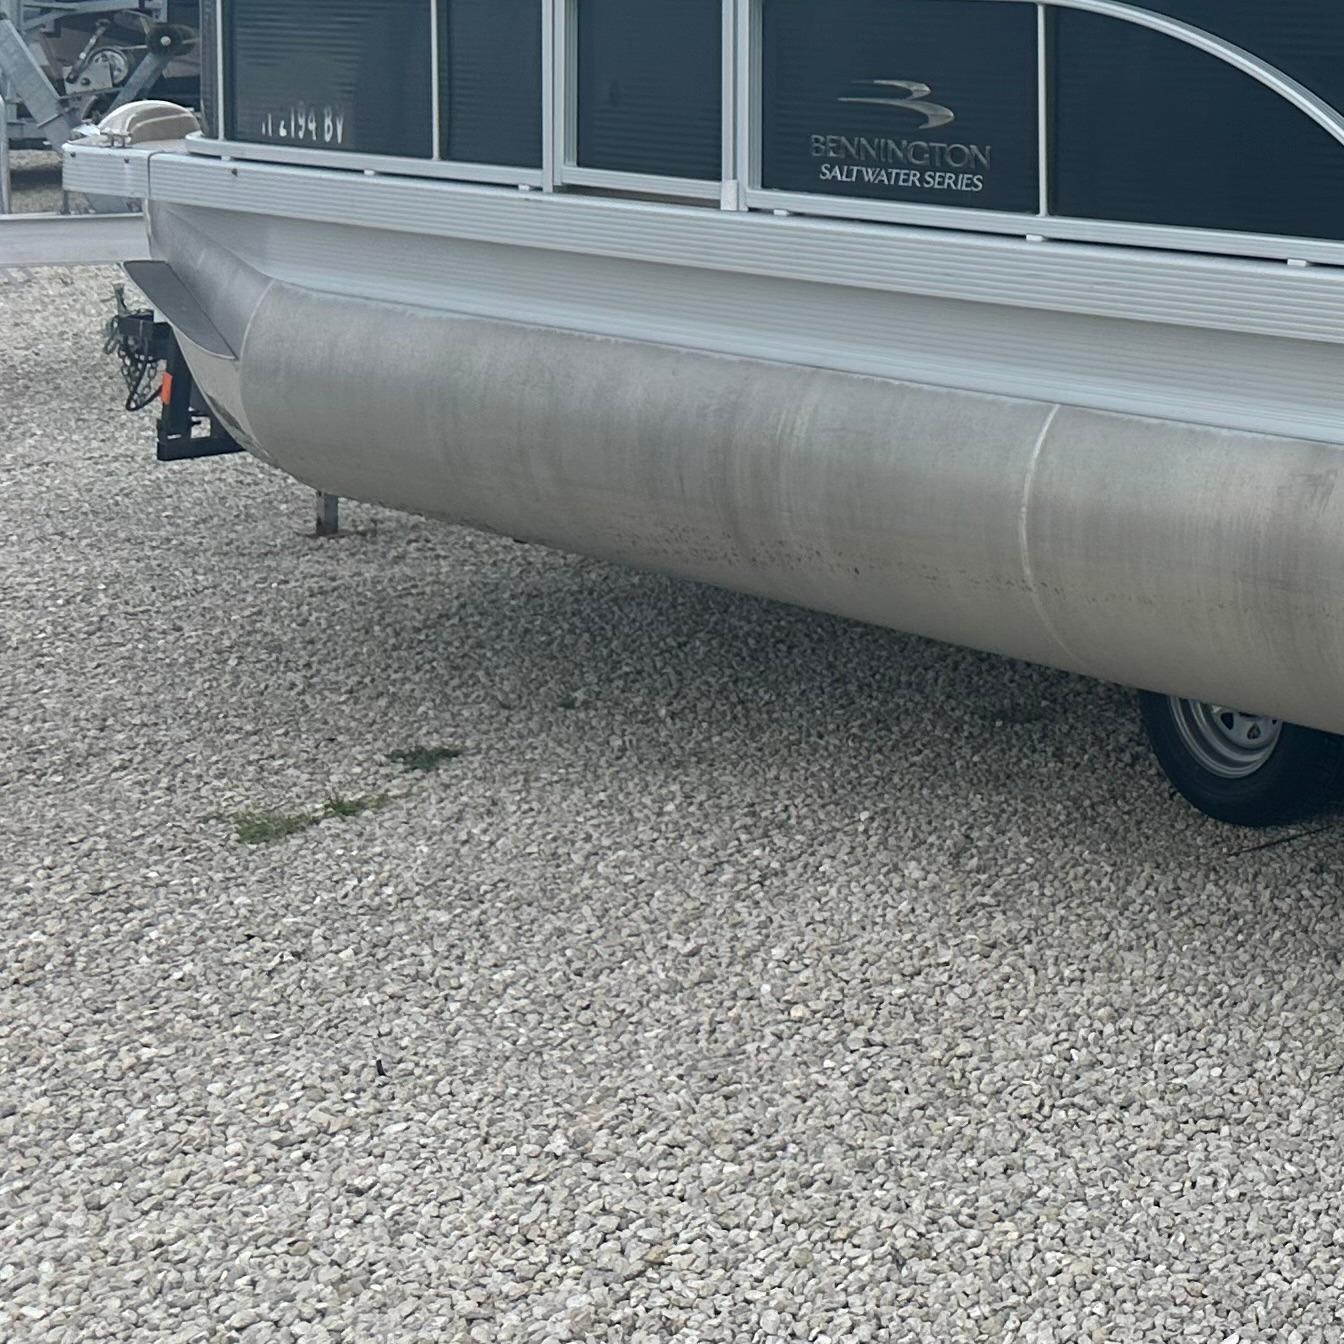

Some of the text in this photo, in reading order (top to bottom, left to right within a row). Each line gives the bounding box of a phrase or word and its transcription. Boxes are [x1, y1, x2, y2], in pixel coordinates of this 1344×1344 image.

[811, 134, 992, 170] BENNINGTON
[819, 163, 984, 192] SALTWATER SERIES
